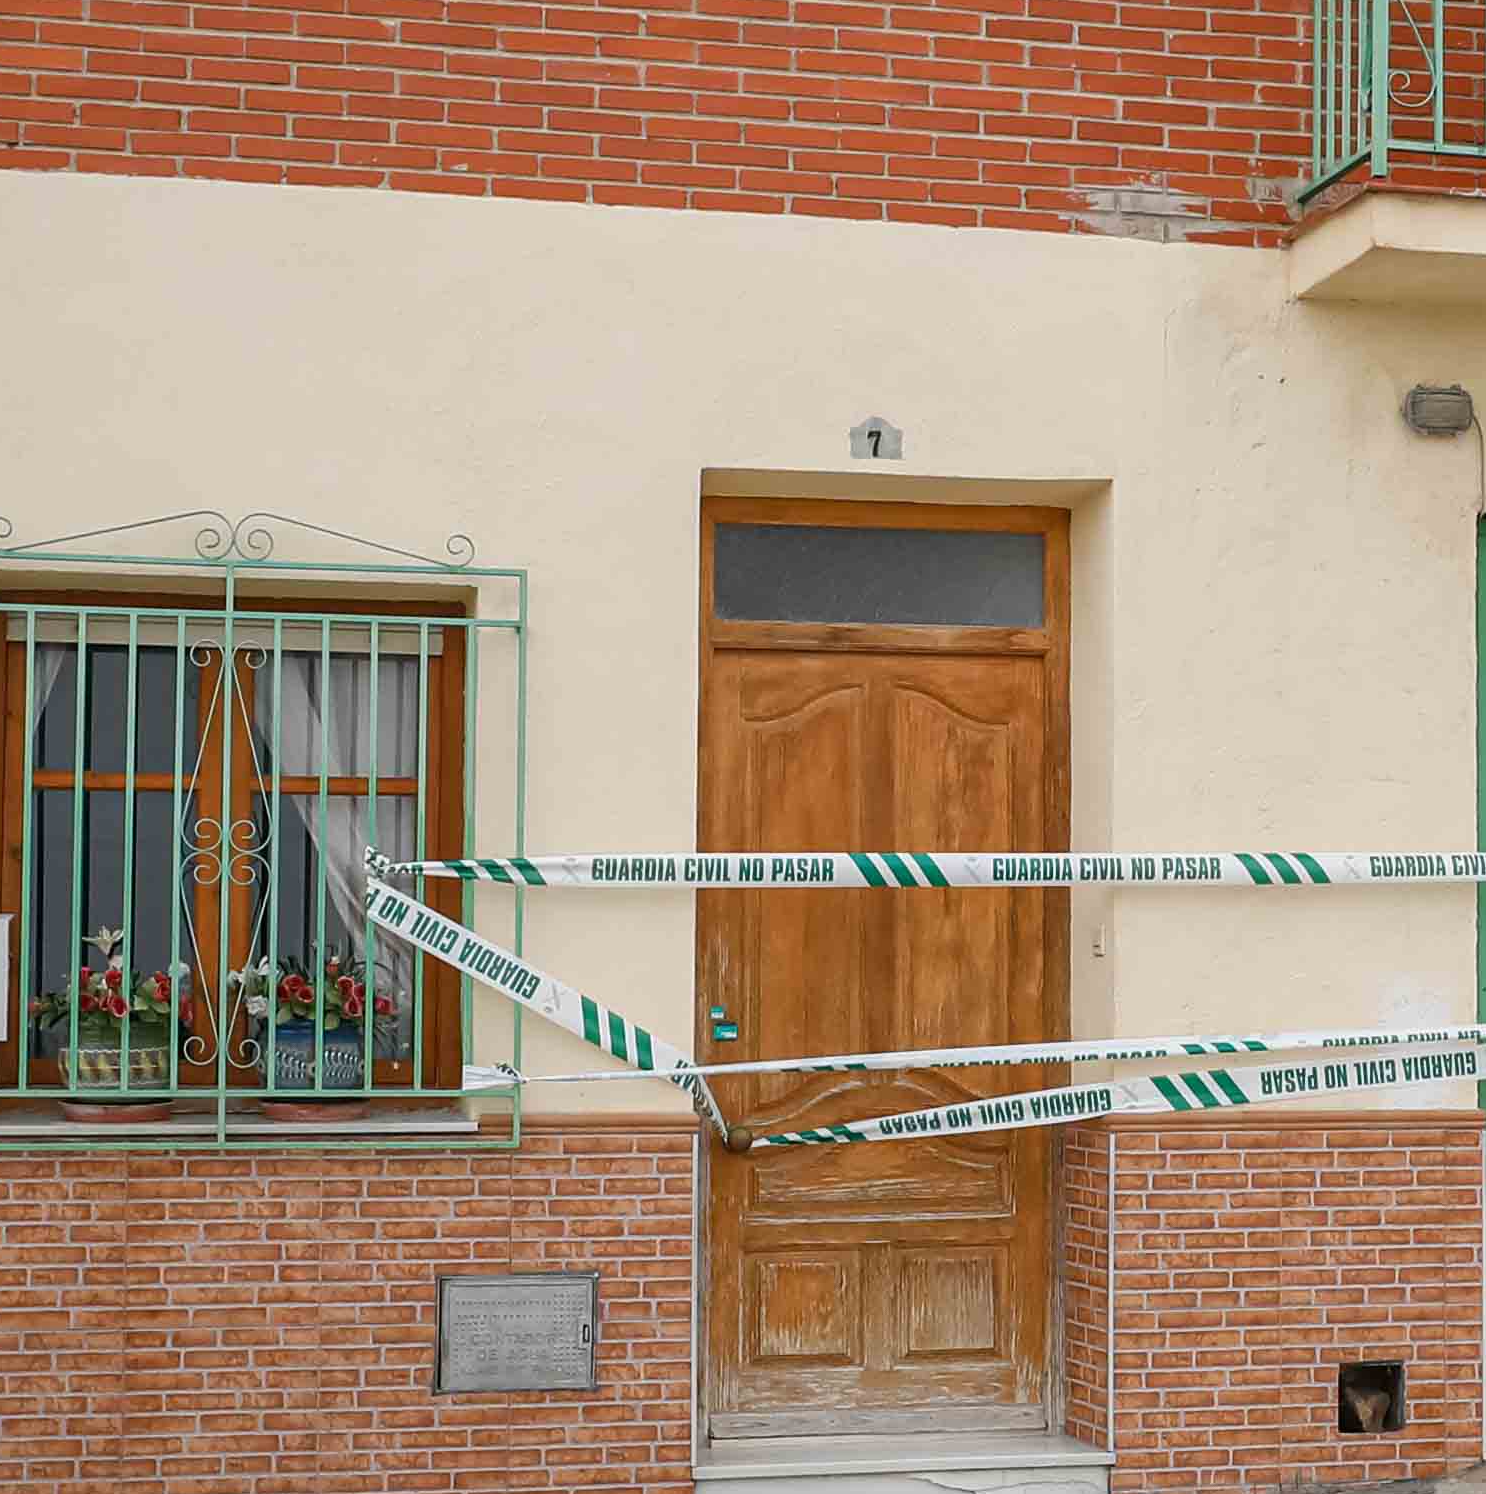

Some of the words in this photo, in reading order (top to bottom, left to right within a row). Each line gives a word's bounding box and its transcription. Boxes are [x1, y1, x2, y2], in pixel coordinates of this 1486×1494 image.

[867, 430, 882, 458] 7
[591, 857, 676, 882] GUARDIA
[683, 857, 731, 882] CIVIL
[737, 857, 764, 882] NO
[770, 857, 834, 882] PASAR
[992, 857, 1072, 881] GUARDIA
[1079, 857, 1124, 881] CIVIL
[1131, 857, 1156, 880] NO
[1162, 856, 1222, 880] PASAR
[1369, 854, 1446, 877] GUARDIA
[378, 895, 409, 928] NO
[410, 908, 460, 954] CIVIL
[458, 938, 541, 1001] GUARDIA
[1324, 1063, 1348, 1089] NO
[1353, 1058, 1397, 1086] CIVIL
[1402, 1051, 1476, 1082] GUARDIA
[1260, 1067, 1318, 1095] PASAR
[980, 1099, 1025, 1124] CIVIL
[1031, 1088, 1112, 1117] GUARDIA
[879, 1114, 941, 1135] PASAR
[946, 1108, 972, 1129] NO
